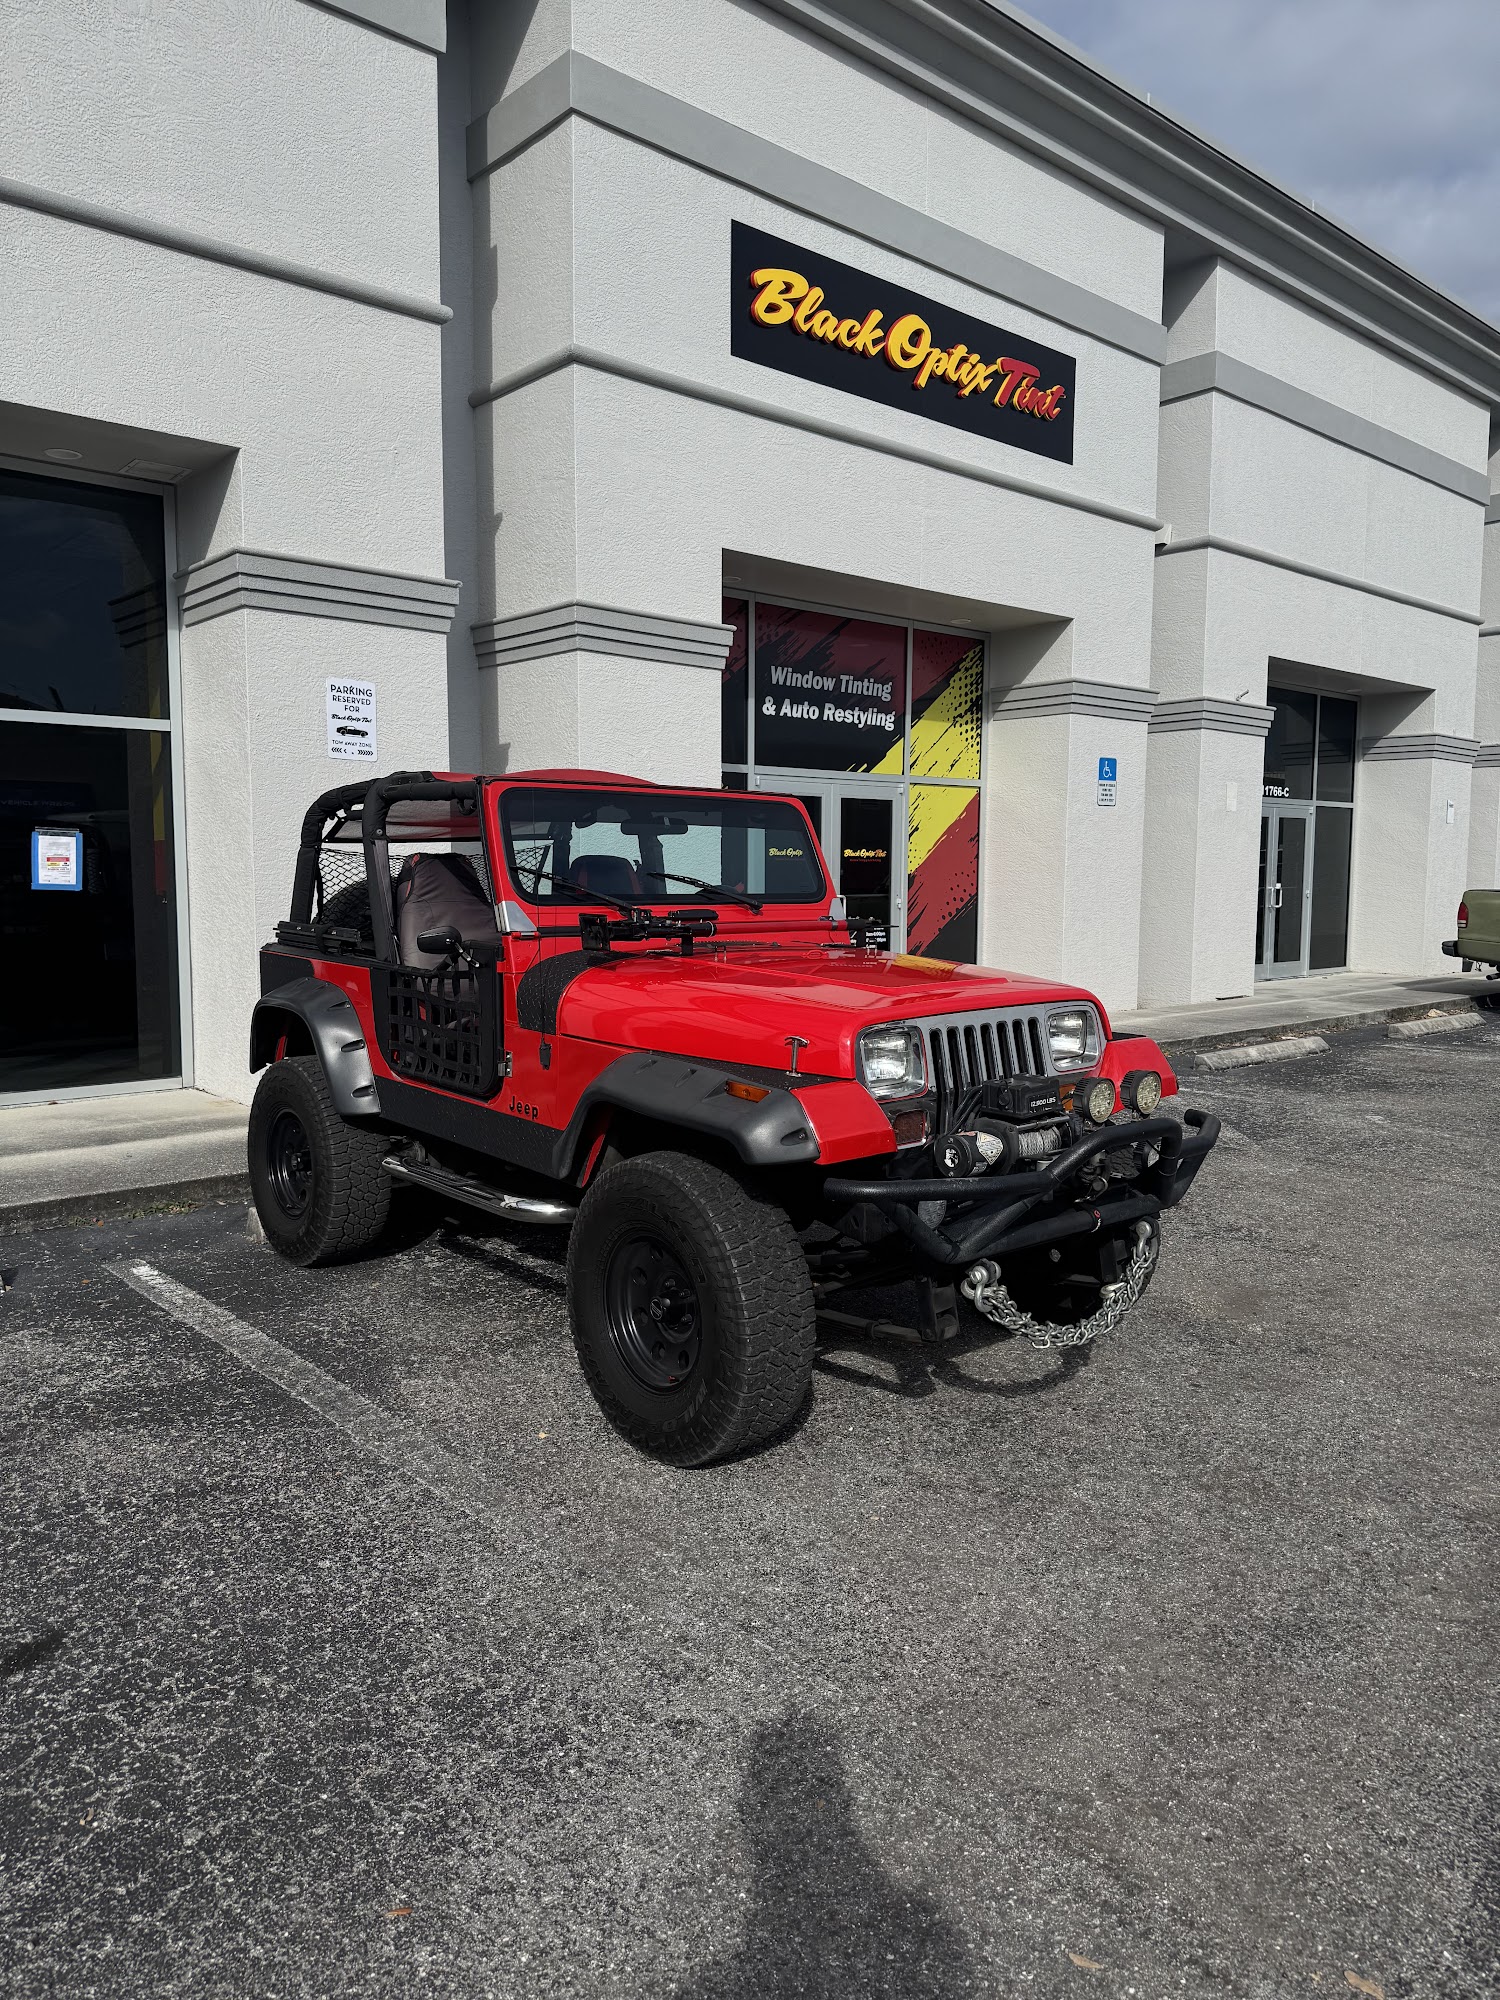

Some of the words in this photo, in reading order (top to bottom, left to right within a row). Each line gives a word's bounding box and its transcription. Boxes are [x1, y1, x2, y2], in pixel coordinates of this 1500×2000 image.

[750, 268, 886, 358] Black
[885, 313, 998, 398] Optix
[994, 357, 1067, 421] Tint
[330, 684, 373, 697] PARKING
[770, 665, 836, 691] Window
[839, 674, 893, 701] Tinting
[332, 694, 371, 705] RESERVED
[344, 705, 360, 713] FOR
[762, 696, 776, 716] &
[779, 698, 819, 720] Auto
[822, 703, 895, 731] Restyling
[509, 1095, 538, 1120] Jeep
